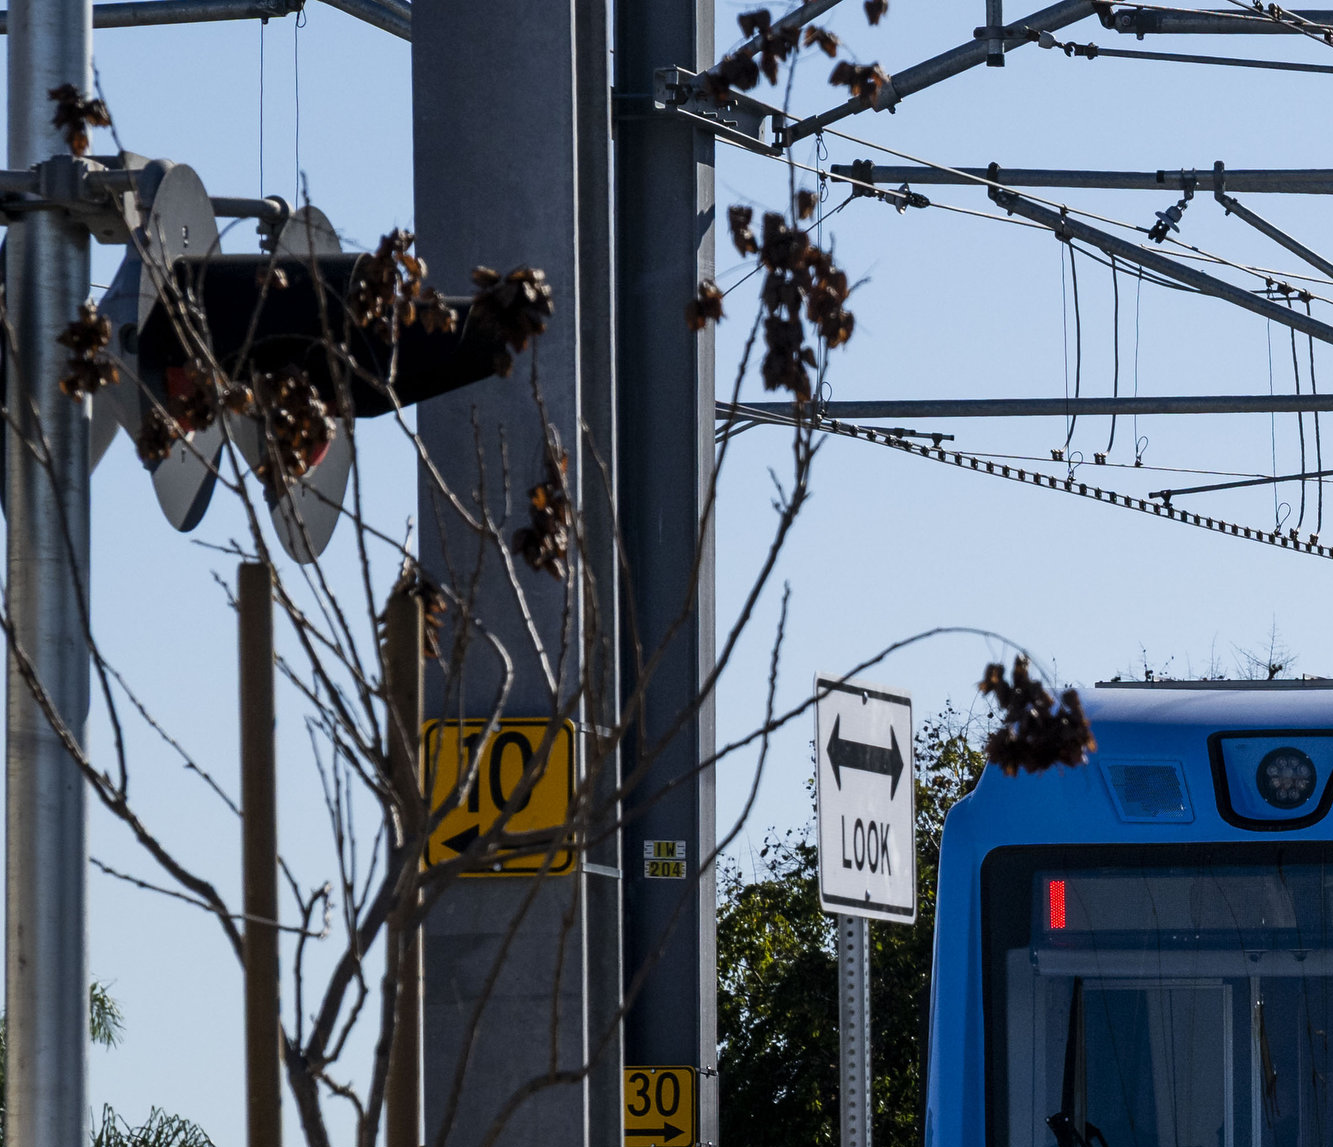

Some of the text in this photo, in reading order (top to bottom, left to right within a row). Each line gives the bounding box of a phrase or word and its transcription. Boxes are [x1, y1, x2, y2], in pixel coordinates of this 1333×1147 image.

[463, 731, 533, 814] 10
[650, 861, 681, 877] 204
[841, 814, 892, 876] LOOK
[627, 1071, 681, 1117] 30
